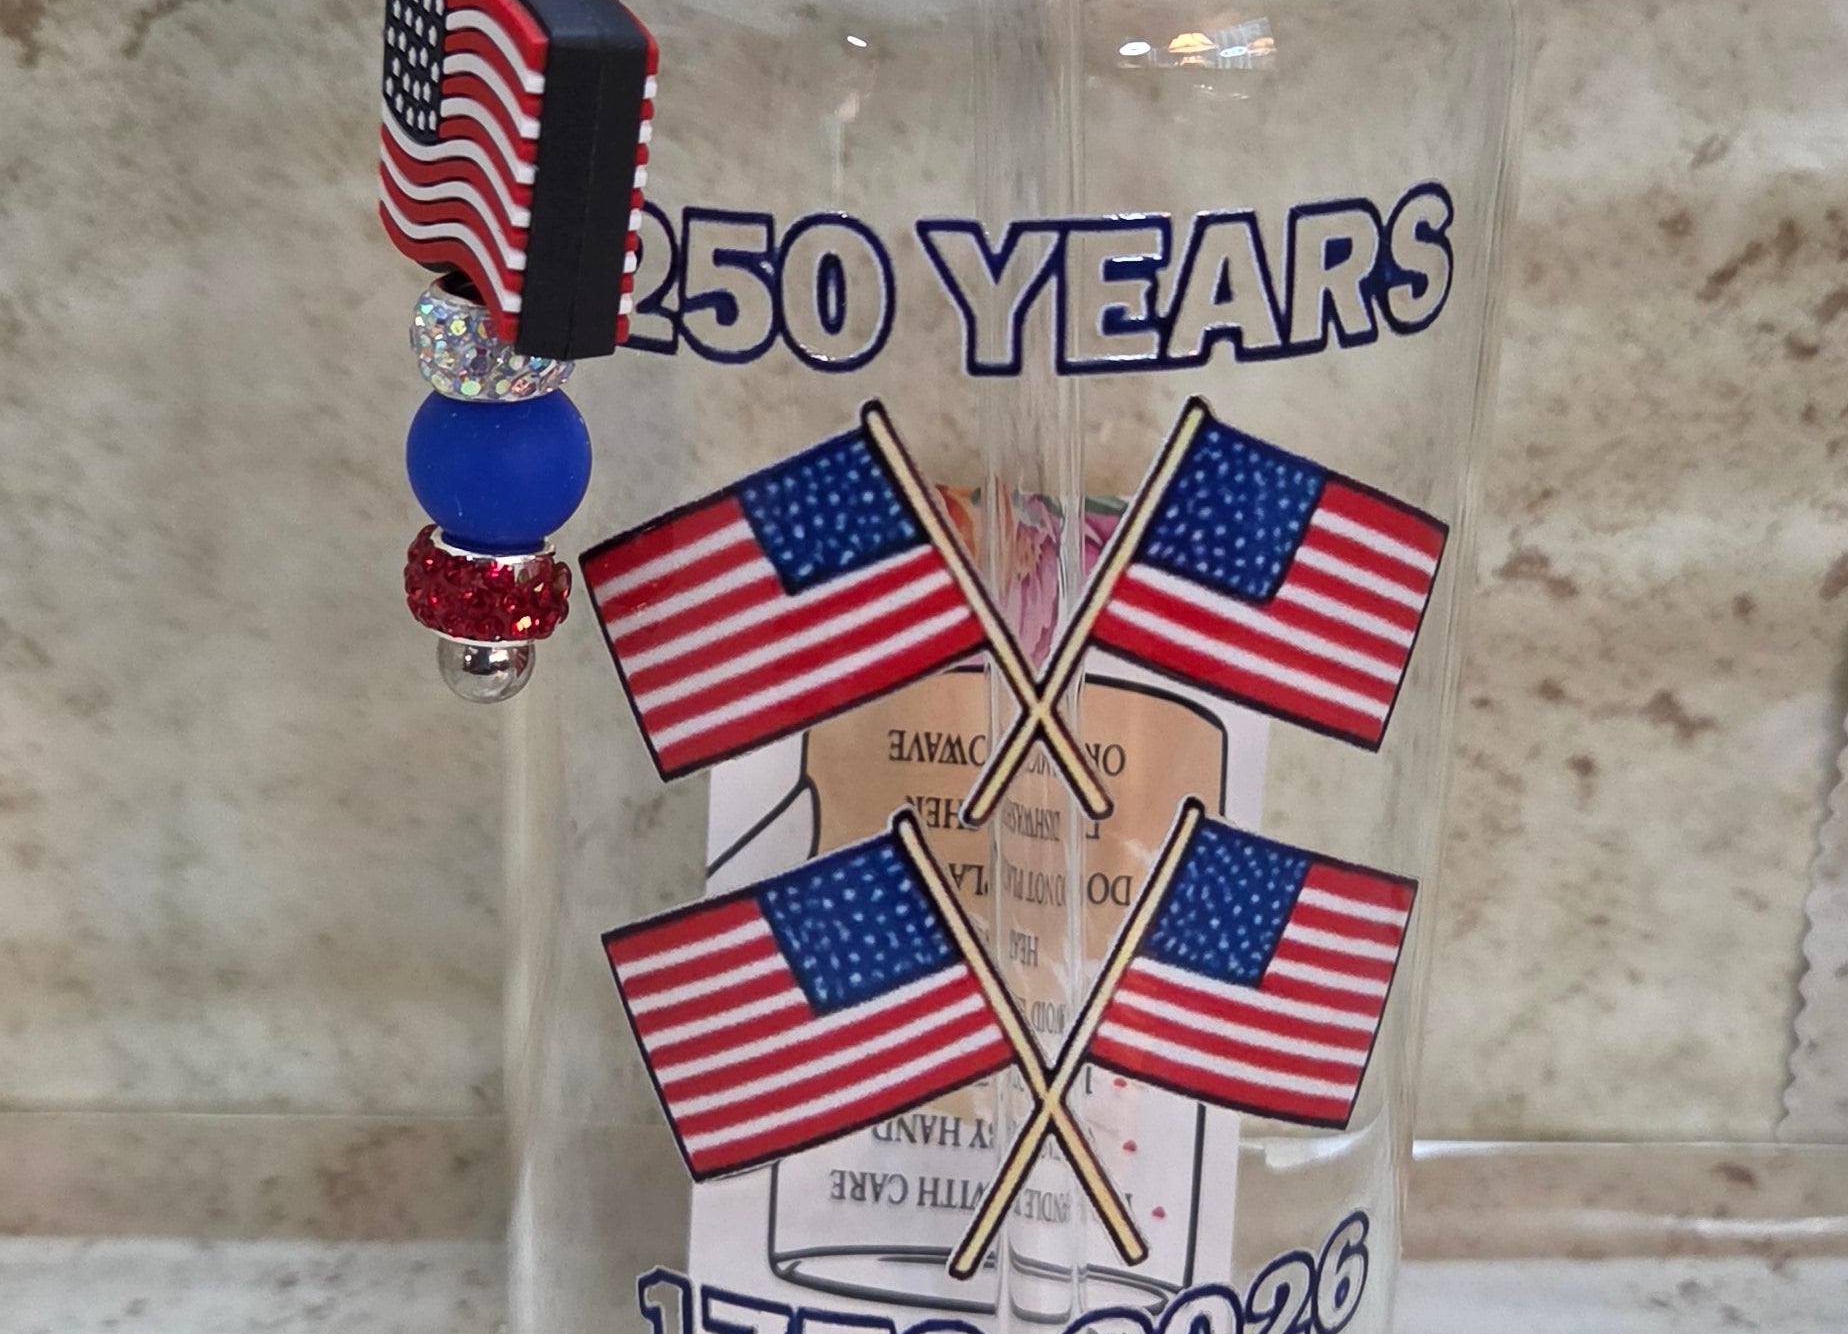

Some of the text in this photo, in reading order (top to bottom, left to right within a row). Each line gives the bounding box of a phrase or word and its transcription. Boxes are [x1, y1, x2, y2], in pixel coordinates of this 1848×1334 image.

[615, 180, 1455, 377] 250 YEARS
[1087, 872, 1133, 907] DO
[871, 1114, 962, 1148] HAND
[829, 1169, 910, 1206] CARE
